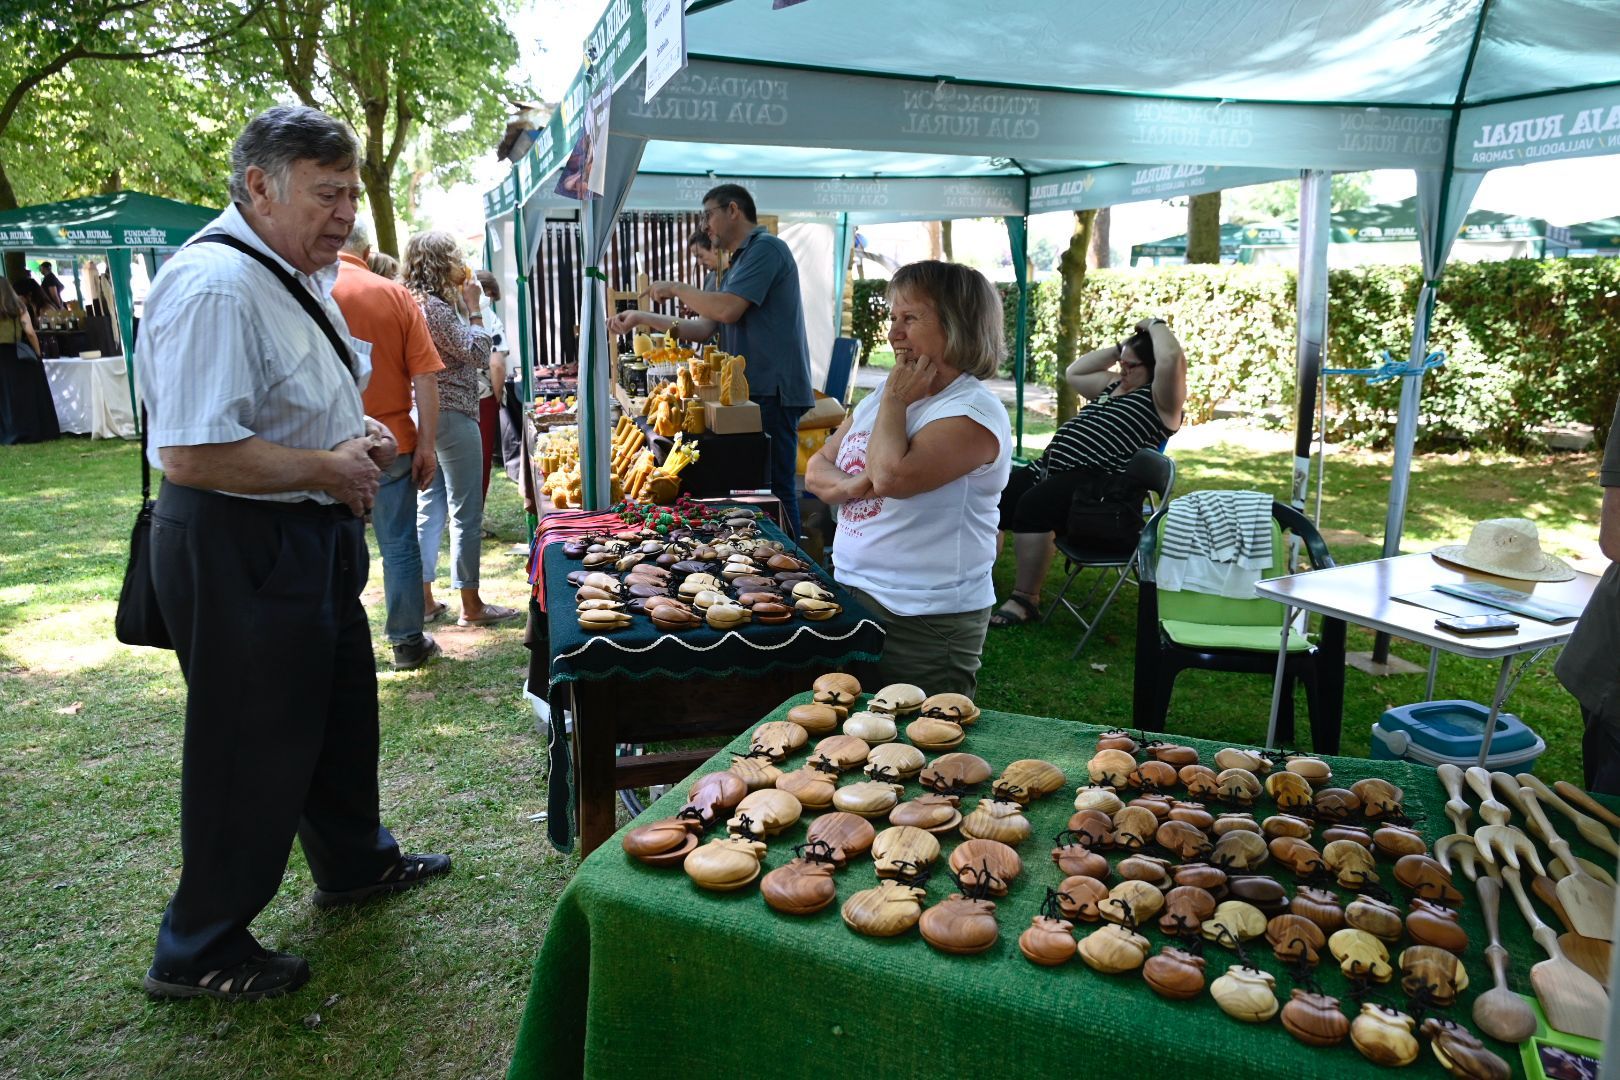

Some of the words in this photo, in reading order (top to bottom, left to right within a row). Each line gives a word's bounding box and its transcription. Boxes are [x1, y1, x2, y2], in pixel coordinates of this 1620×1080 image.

[10, 230, 34, 240] RURAL
[67, 230, 86, 240] CAJA
[86, 230, 112, 239] RURAL
[124, 236, 142, 245] CAJA
[143, 236, 167, 245] RURAL
